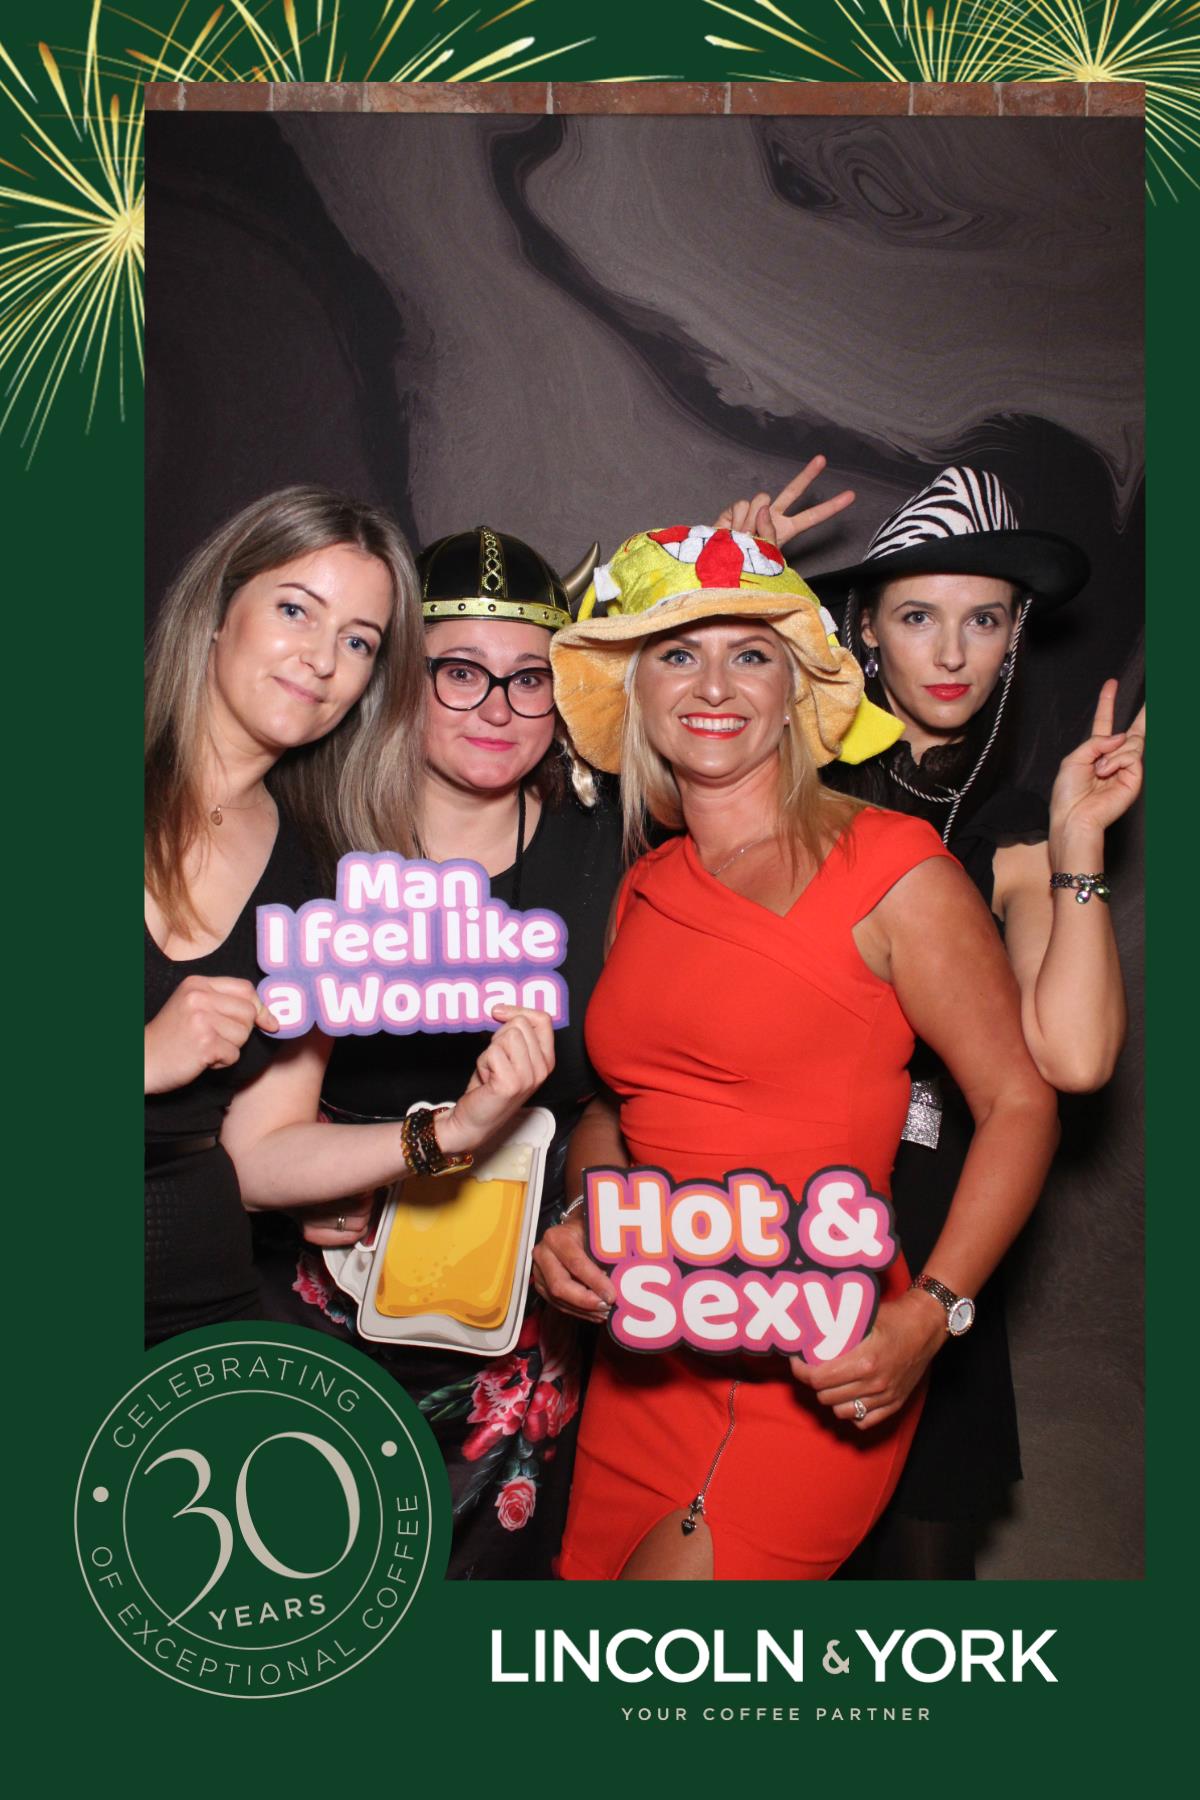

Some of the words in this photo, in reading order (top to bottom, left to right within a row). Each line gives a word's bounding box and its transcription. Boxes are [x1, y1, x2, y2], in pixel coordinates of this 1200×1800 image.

[348, 863, 478, 909] Man
[269, 916, 284, 963] I
[305, 911, 427, 962] feel
[446, 906, 557, 959] like
[268, 986, 302, 1026] a
[320, 976, 557, 1023] Woman
[597, 1181, 780, 1256] Hot
[808, 1181, 883, 1257] &
[620, 1264, 863, 1361] Sexy
